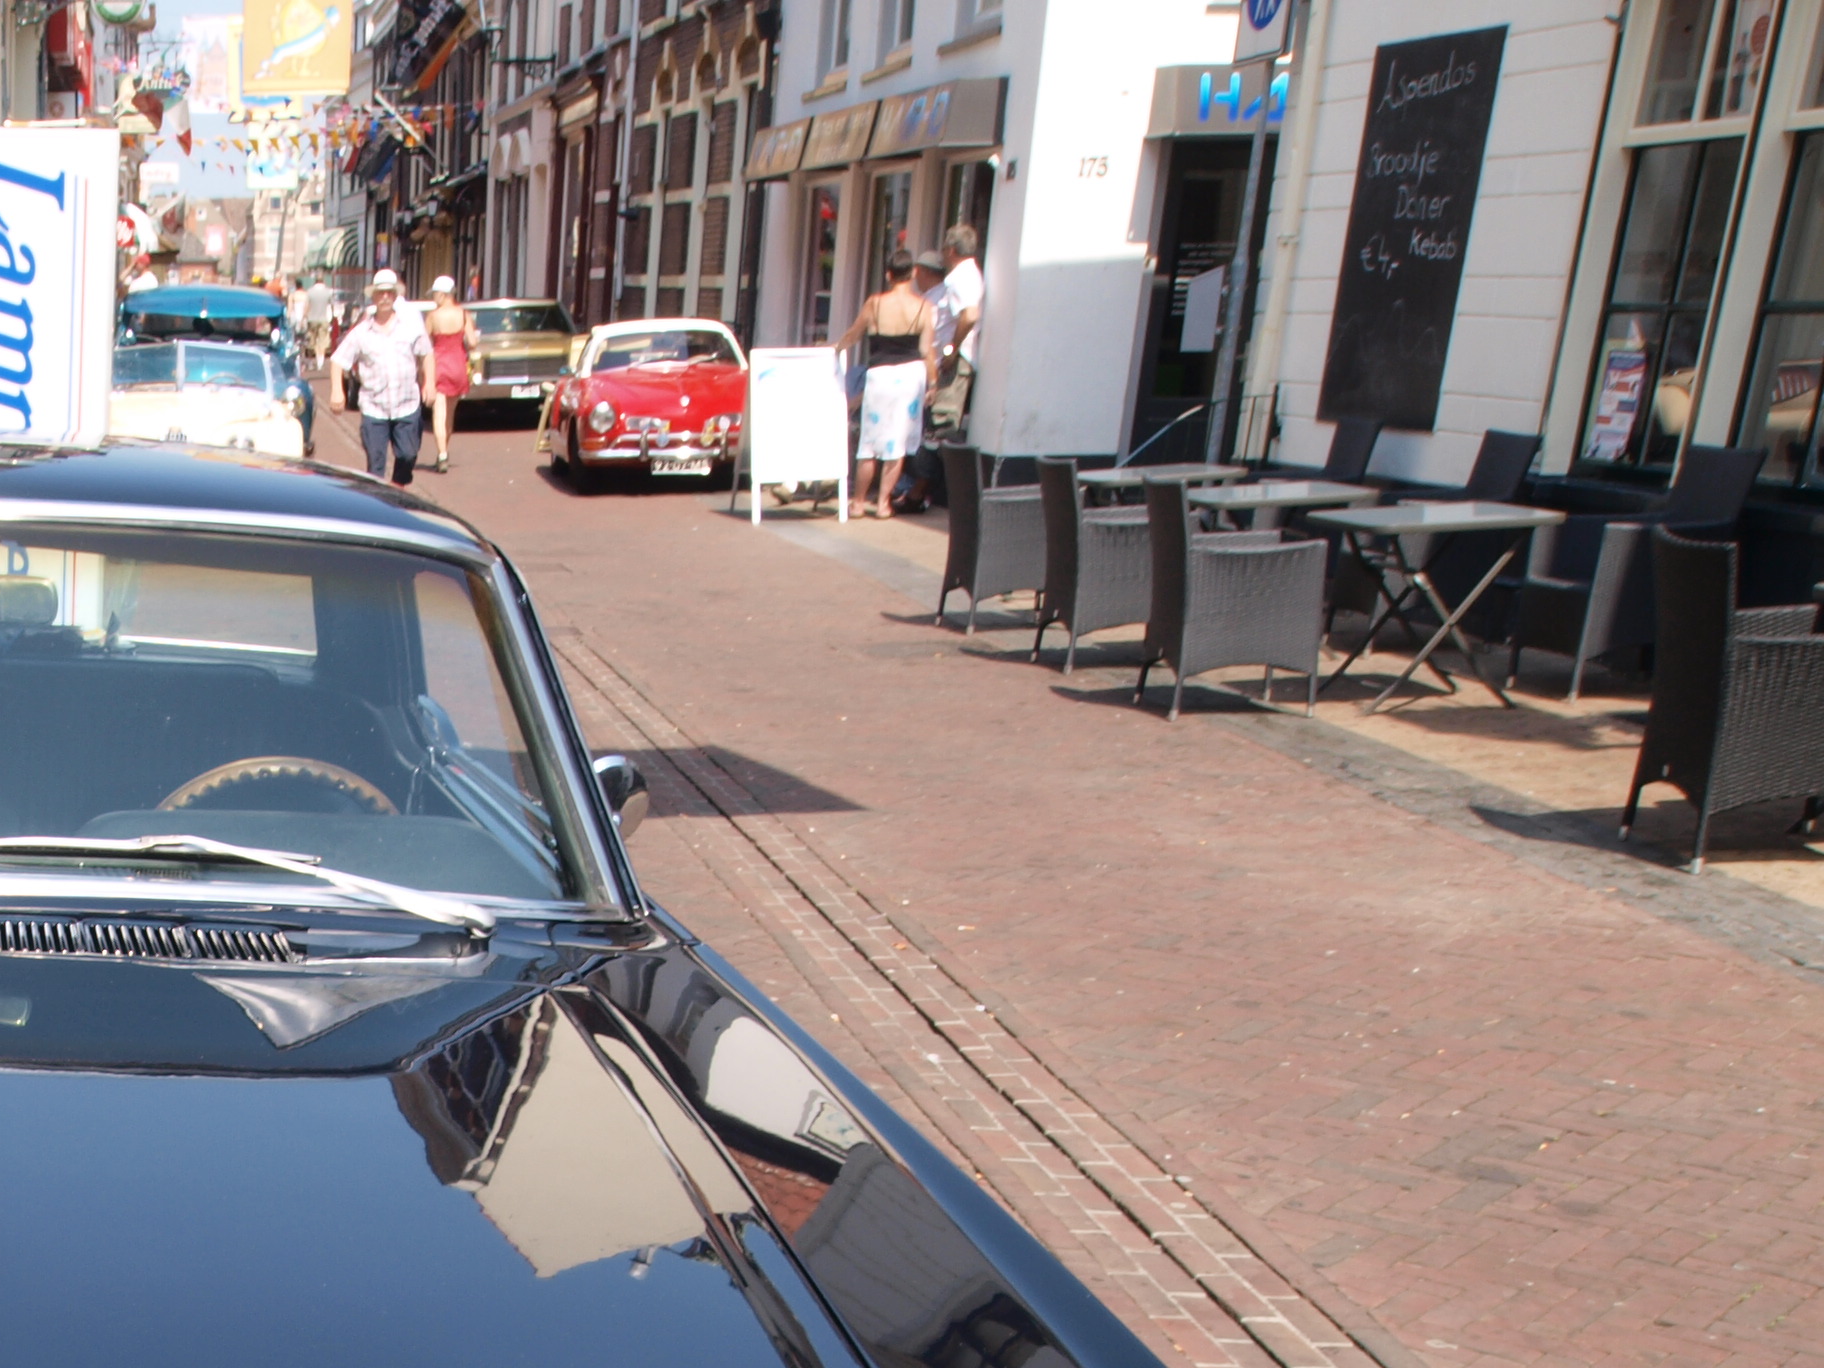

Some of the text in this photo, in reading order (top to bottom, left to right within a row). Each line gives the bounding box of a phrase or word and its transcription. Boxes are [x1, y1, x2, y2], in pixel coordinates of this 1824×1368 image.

[1377, 50, 1476, 113] Aspendos
[1367, 141, 1440, 190] Broodje
[1409, 227, 1457, 260] Kebab
